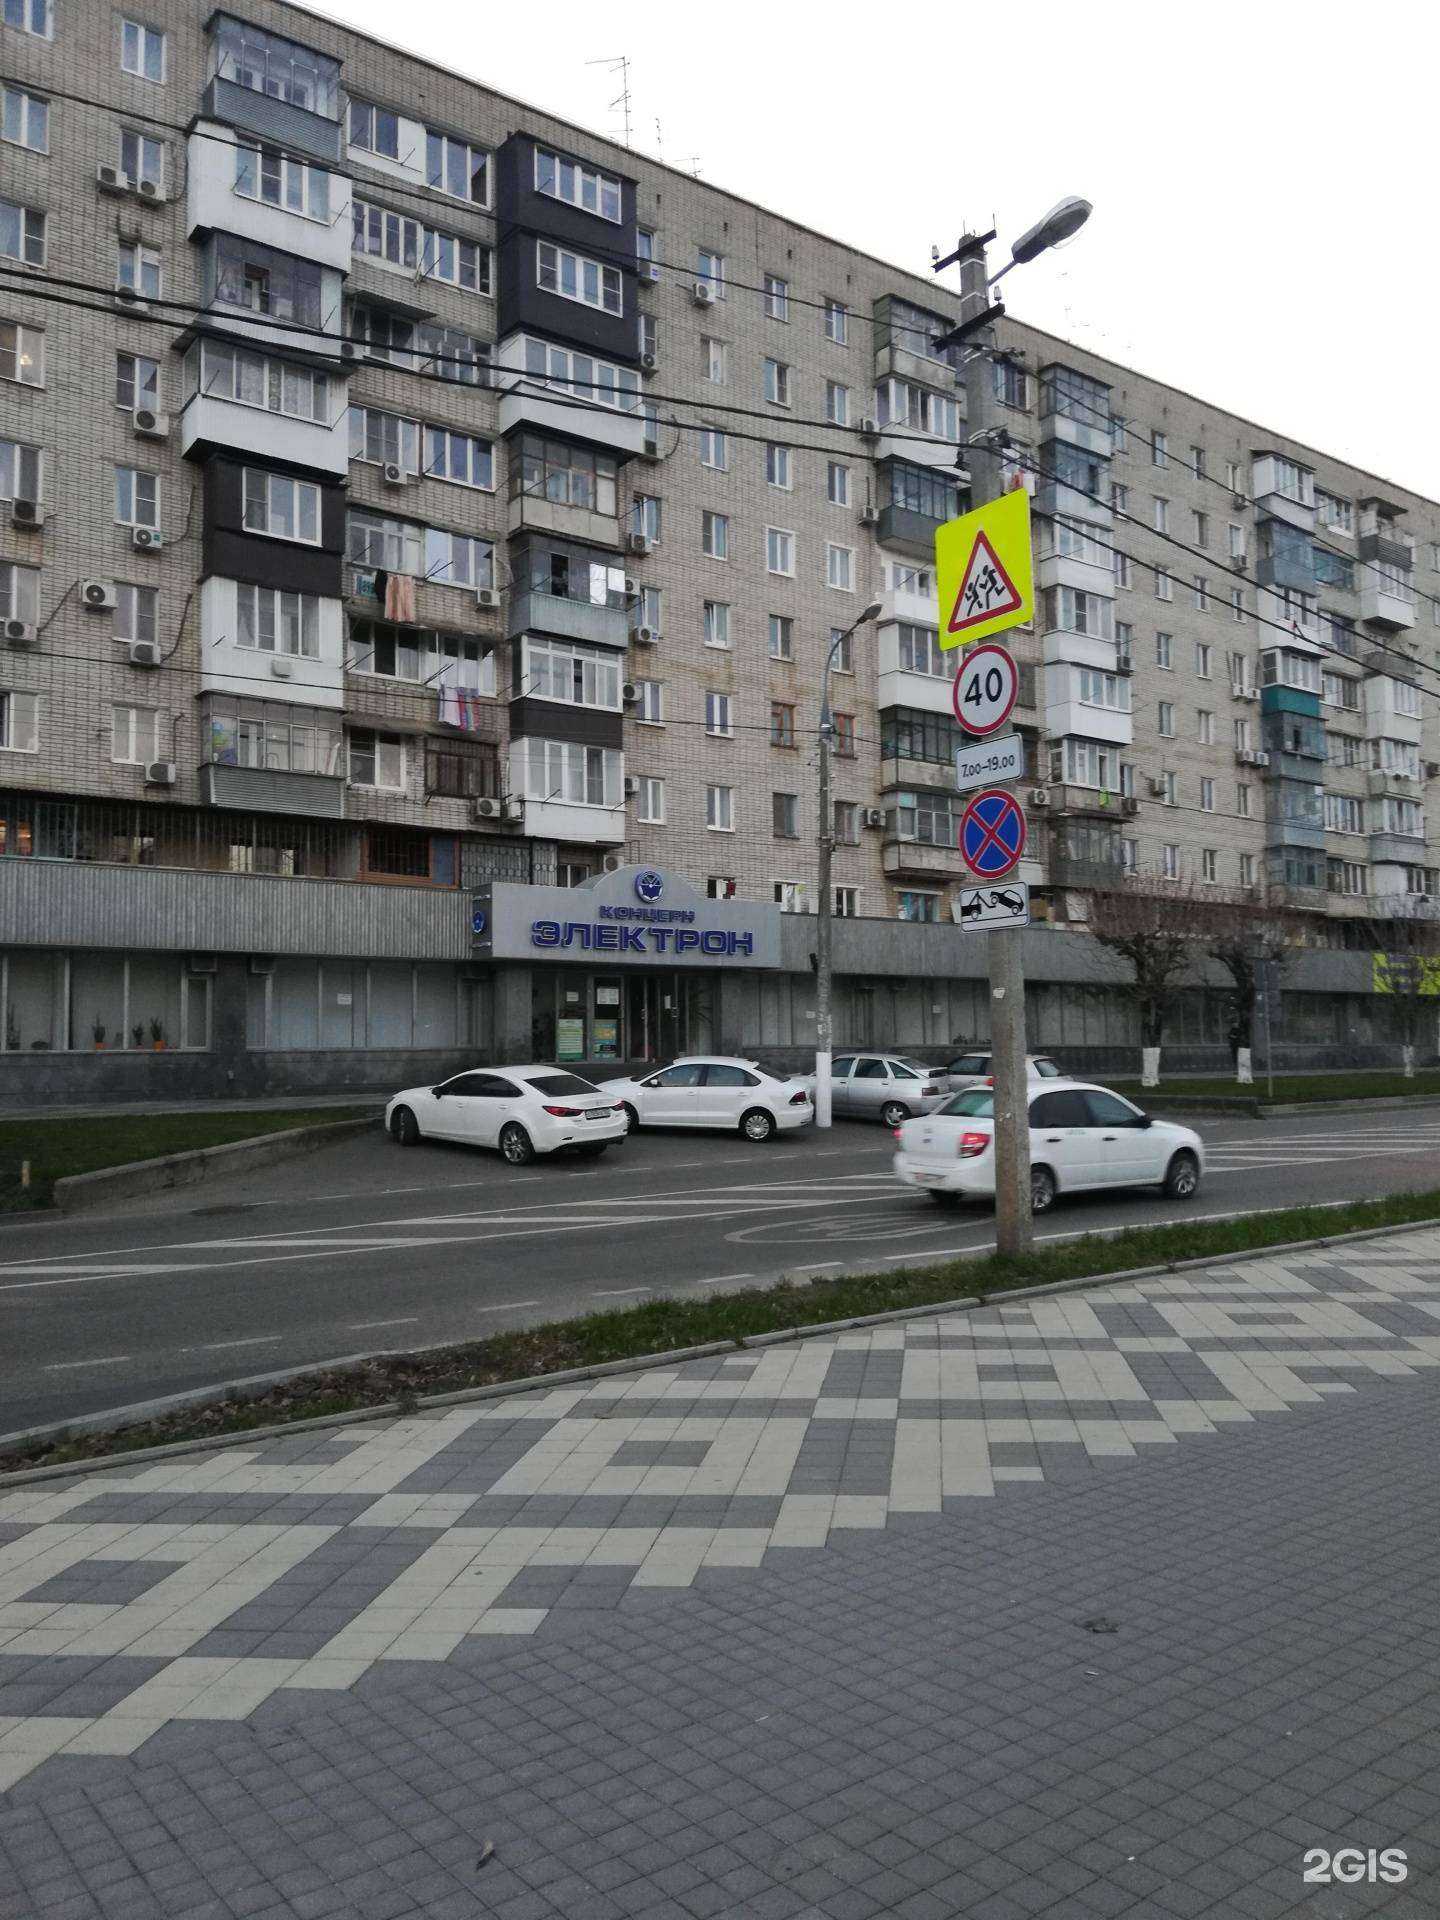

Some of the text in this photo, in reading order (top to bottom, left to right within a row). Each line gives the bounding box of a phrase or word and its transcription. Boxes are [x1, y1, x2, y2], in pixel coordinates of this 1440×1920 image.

[964, 668, 1002, 706] 40
[599, 905, 695, 923] КОНЦЕРН
[532, 920, 753, 956] ЭЛЕКТРОН
